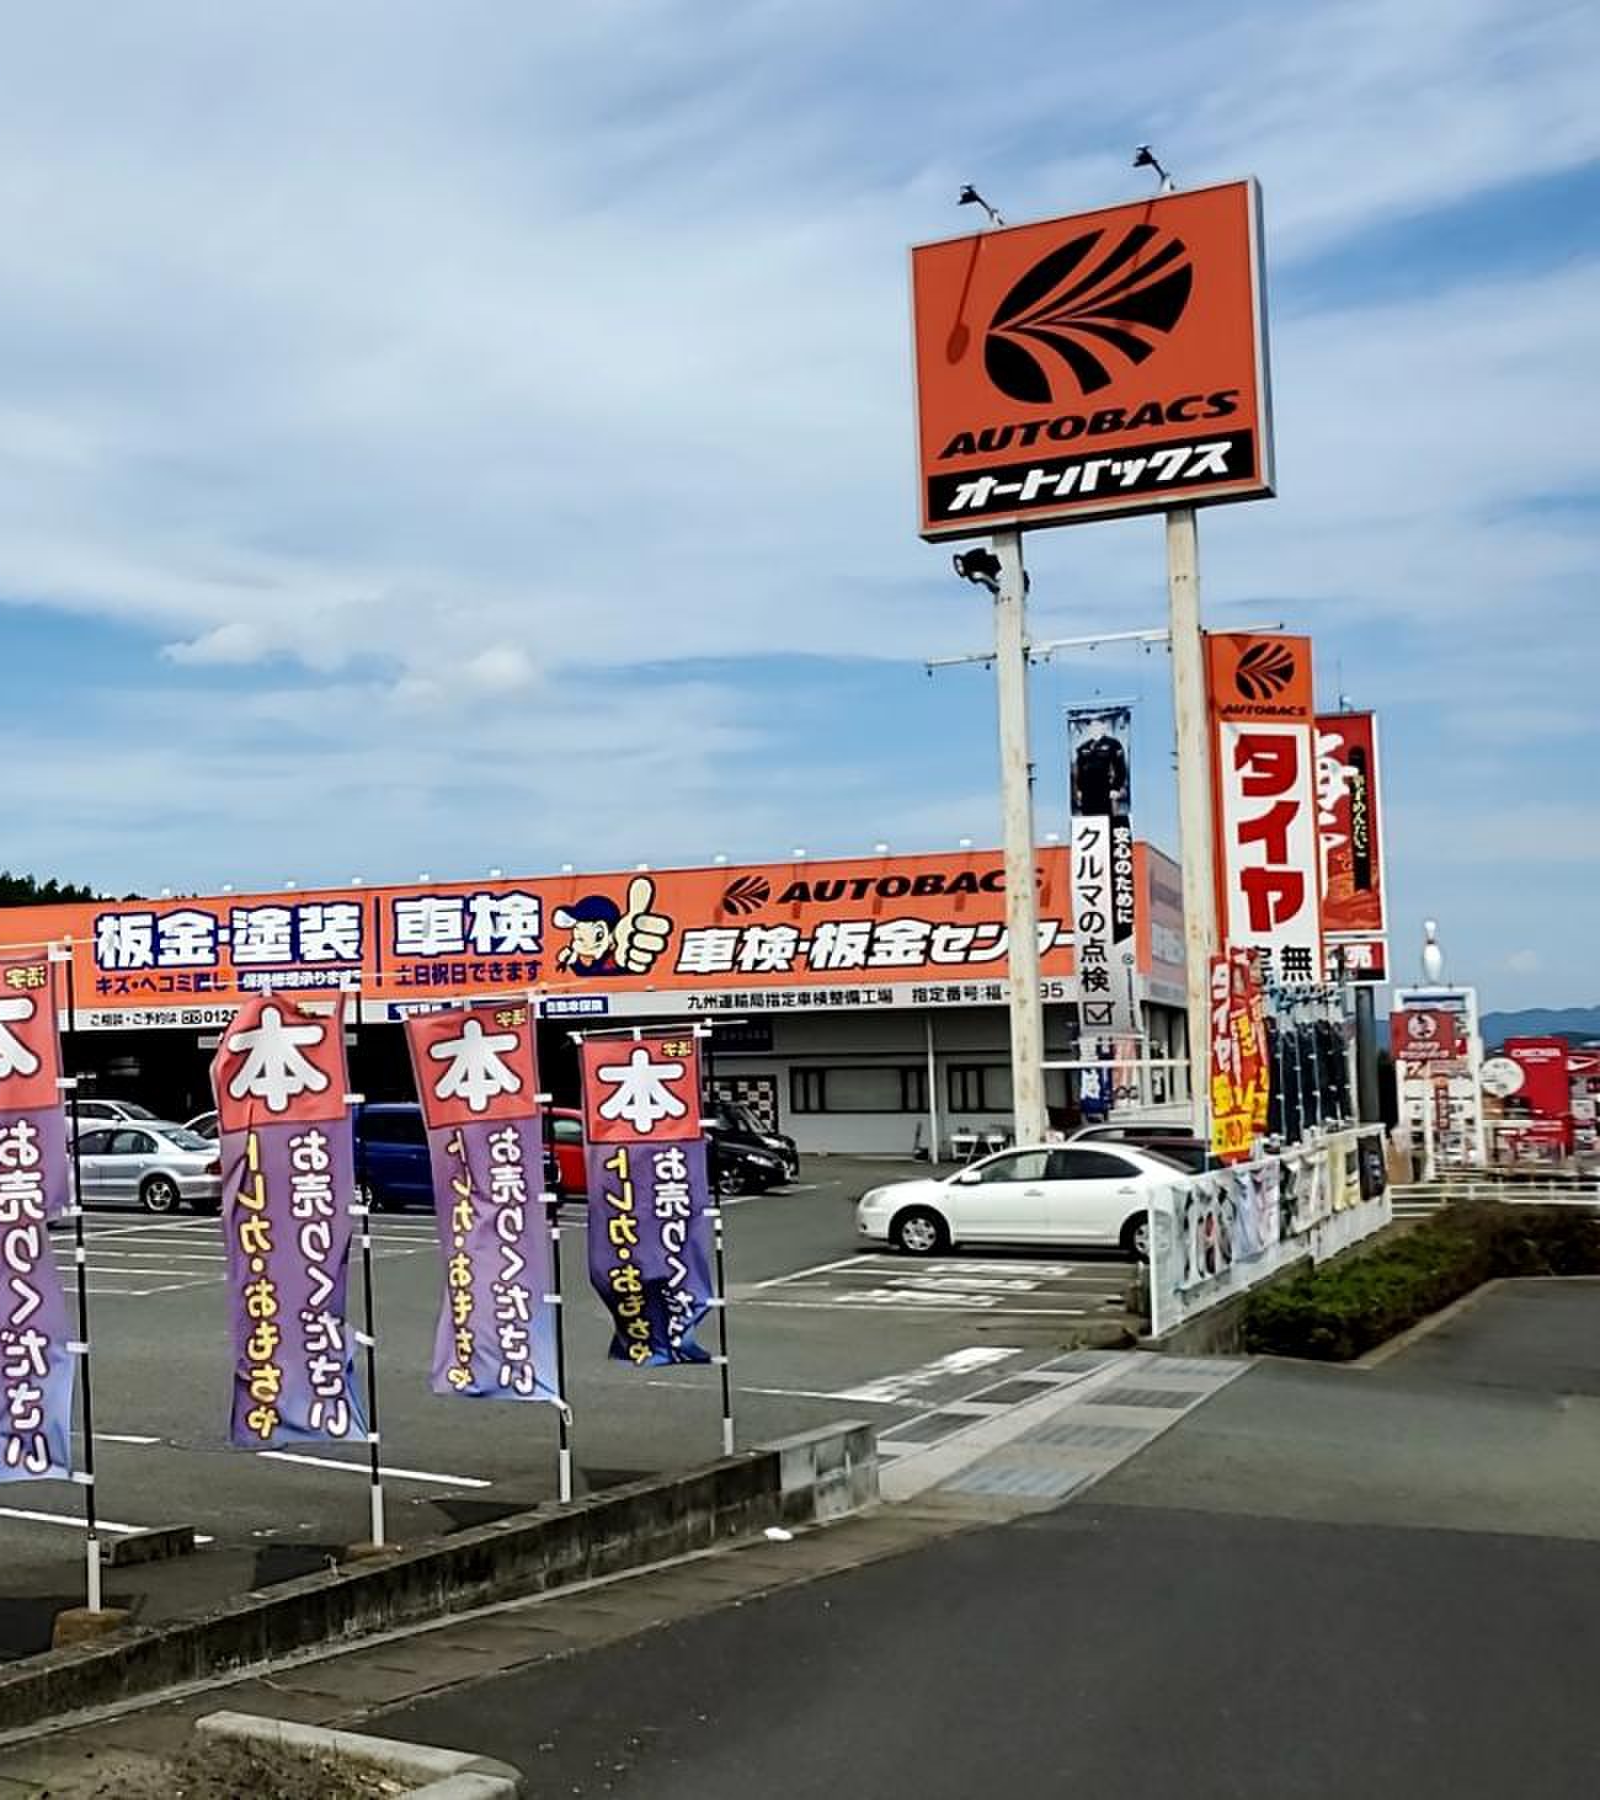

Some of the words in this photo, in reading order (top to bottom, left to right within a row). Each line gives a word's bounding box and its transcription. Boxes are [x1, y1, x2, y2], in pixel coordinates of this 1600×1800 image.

[937, 390, 1240, 460] AUTOBACS
[947, 441, 1233, 511] オートバックス
[1221, 703, 1307, 717] AUTOBACS
[1234, 733, 1304, 933] タイヤ
[777, 868, 1044, 905] AUTOBAC
[1075, 827, 1111, 994] クルマの点検
[95, 903, 362, 970] 板金・塗装
[393, 890, 543, 957] 車検
[394, 959, 543, 986] 土日祝日できます
